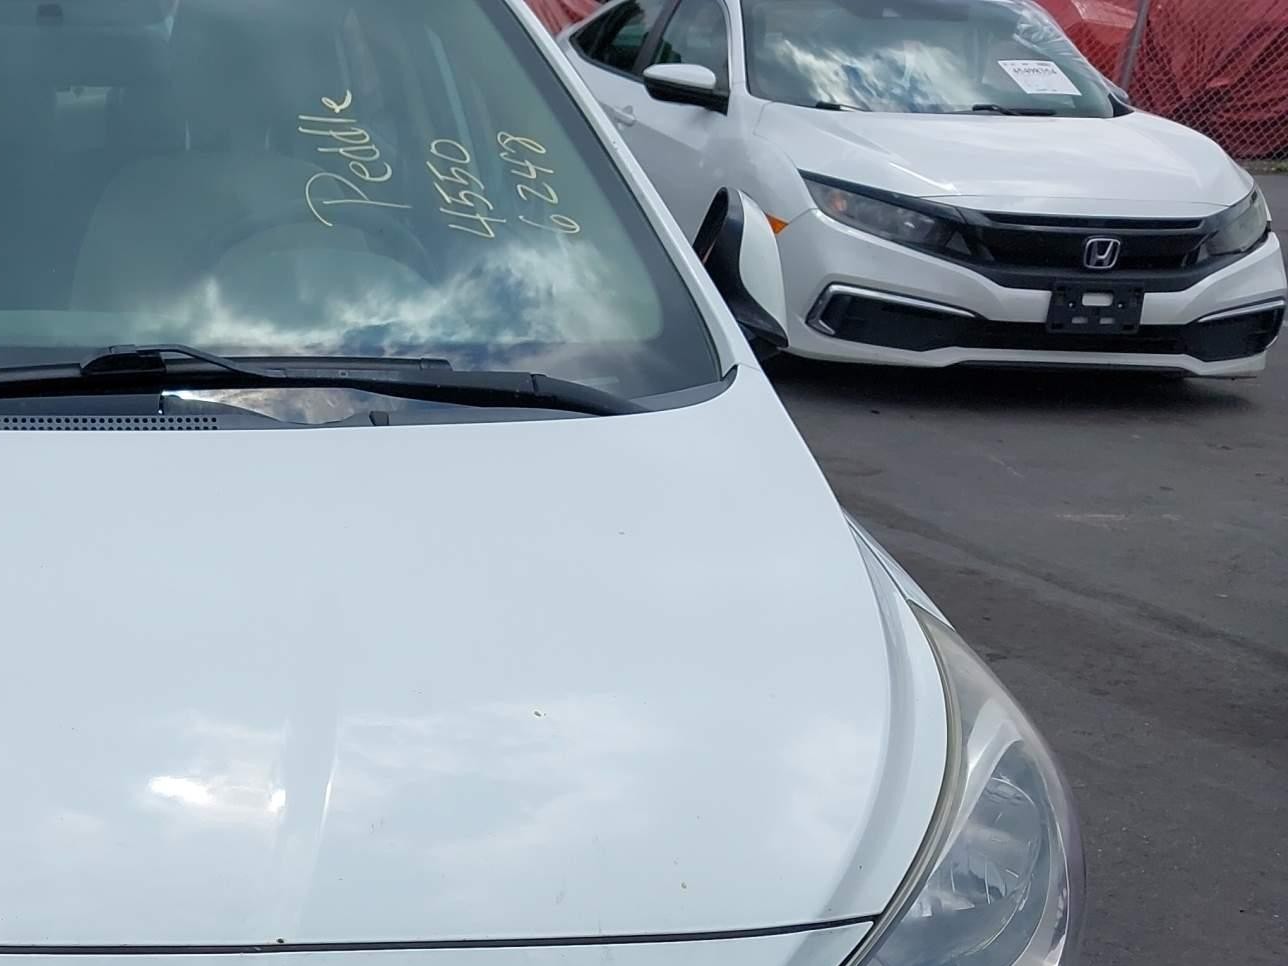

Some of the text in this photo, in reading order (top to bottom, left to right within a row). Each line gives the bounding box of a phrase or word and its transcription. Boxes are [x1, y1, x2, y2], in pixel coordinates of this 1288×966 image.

[298, 89, 412, 226] Peddle
[425, 138, 507, 239] 4550
[497, 131, 580, 234] 6248
